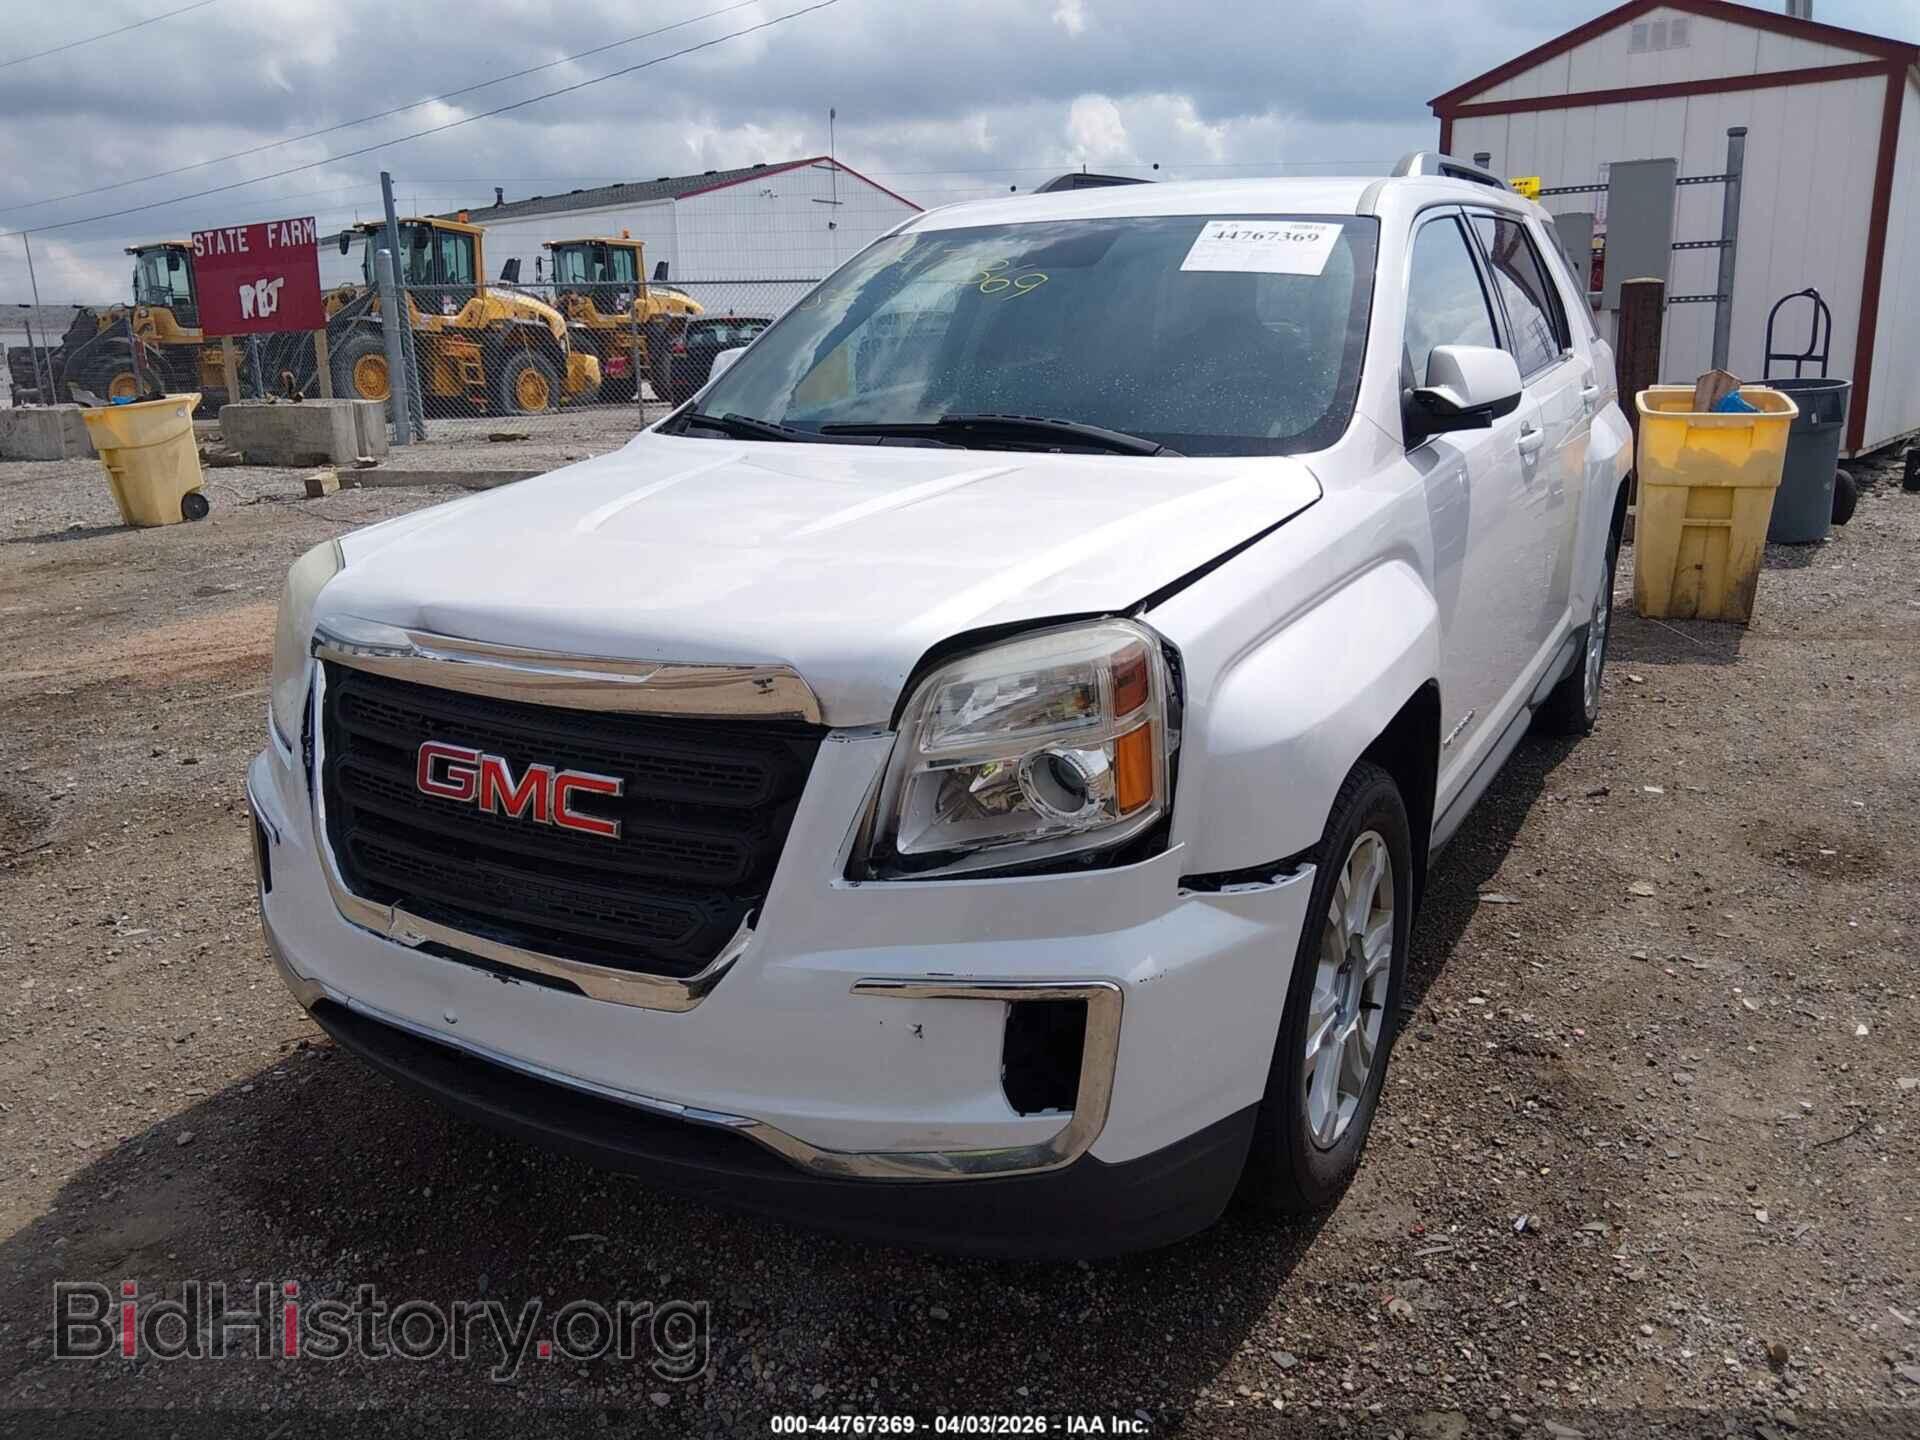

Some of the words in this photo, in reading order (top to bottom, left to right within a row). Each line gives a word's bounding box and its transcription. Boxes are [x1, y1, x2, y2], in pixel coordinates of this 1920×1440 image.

[192, 227, 249, 257] STATE
[267, 218, 316, 249] FARM
[1213, 230, 1320, 242] 44767369
[416, 740, 624, 839] GMC
